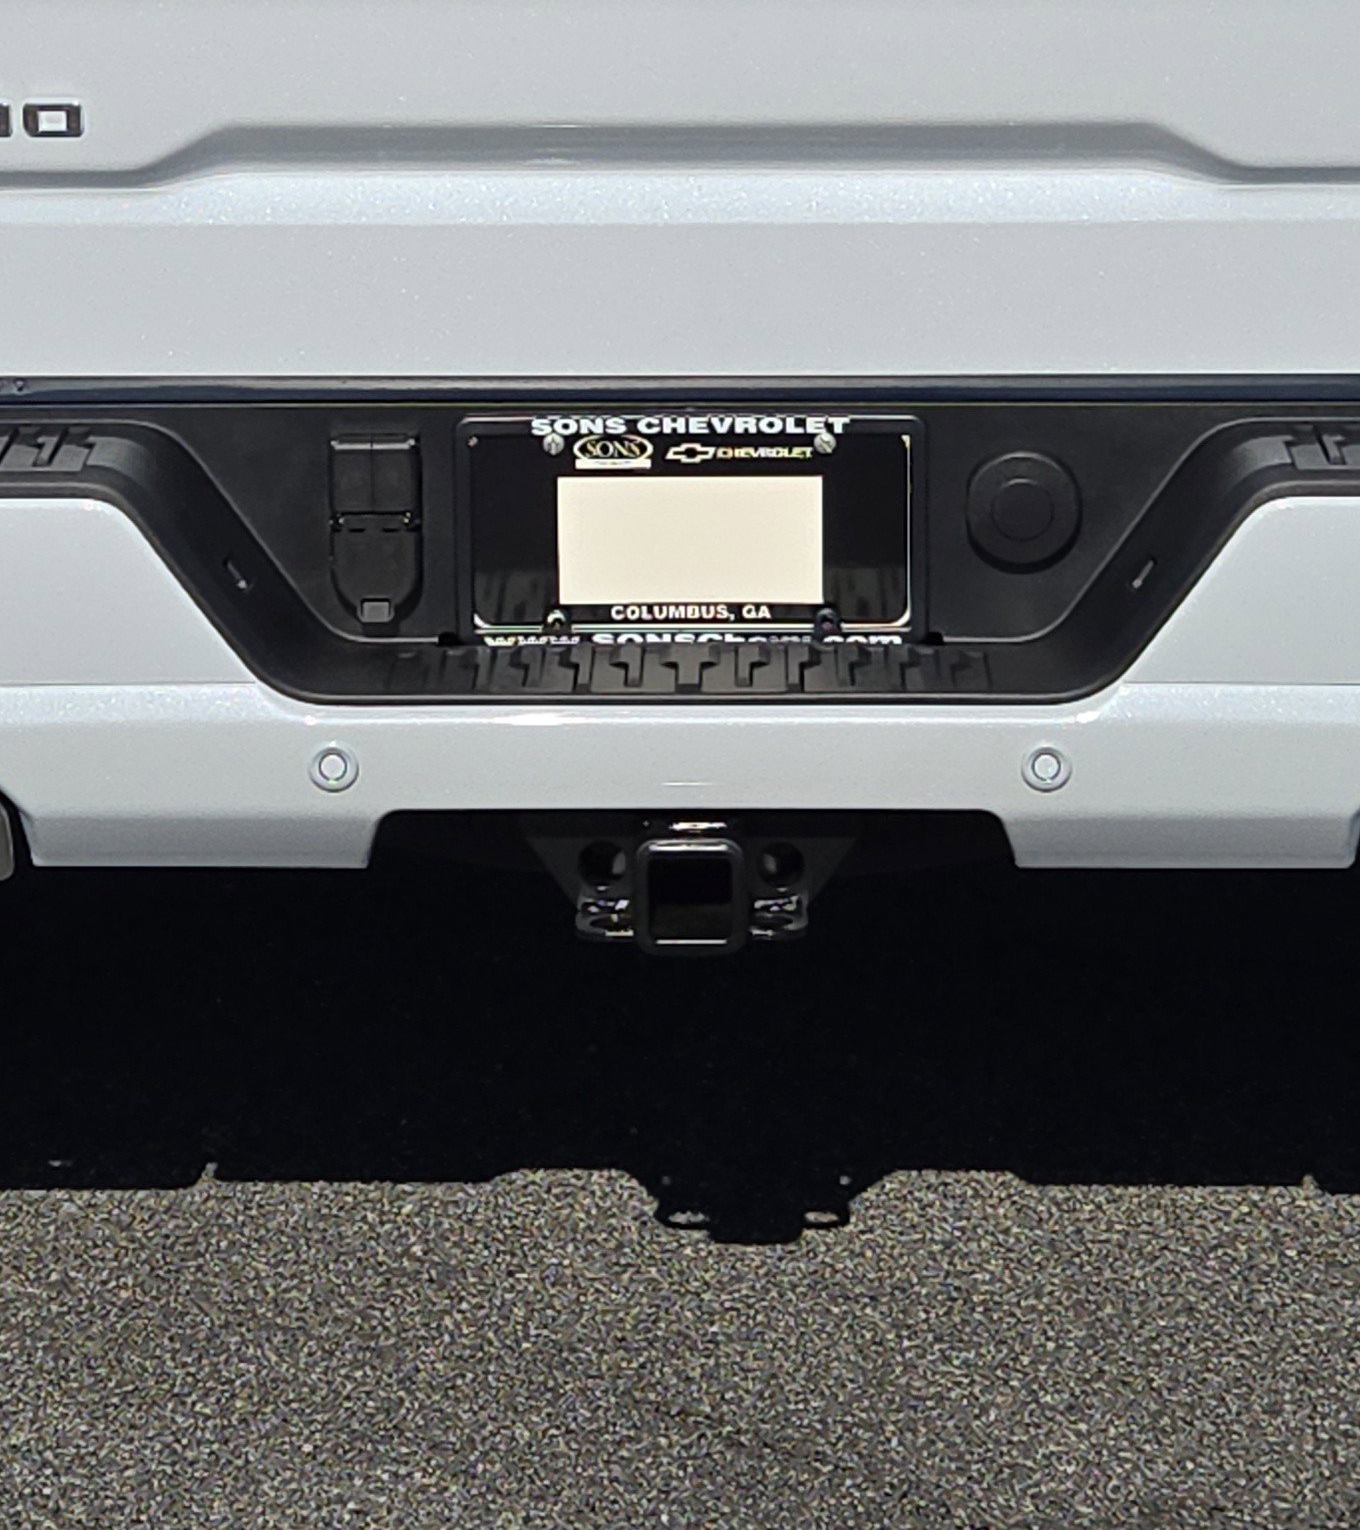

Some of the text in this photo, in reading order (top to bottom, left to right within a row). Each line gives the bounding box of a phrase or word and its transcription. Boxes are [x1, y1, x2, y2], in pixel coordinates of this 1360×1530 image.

[531, 416, 851, 436] SONS CHEVROLET
[583, 439, 642, 458] SONS
[610, 604, 772, 621] COLUMBUS, GA
